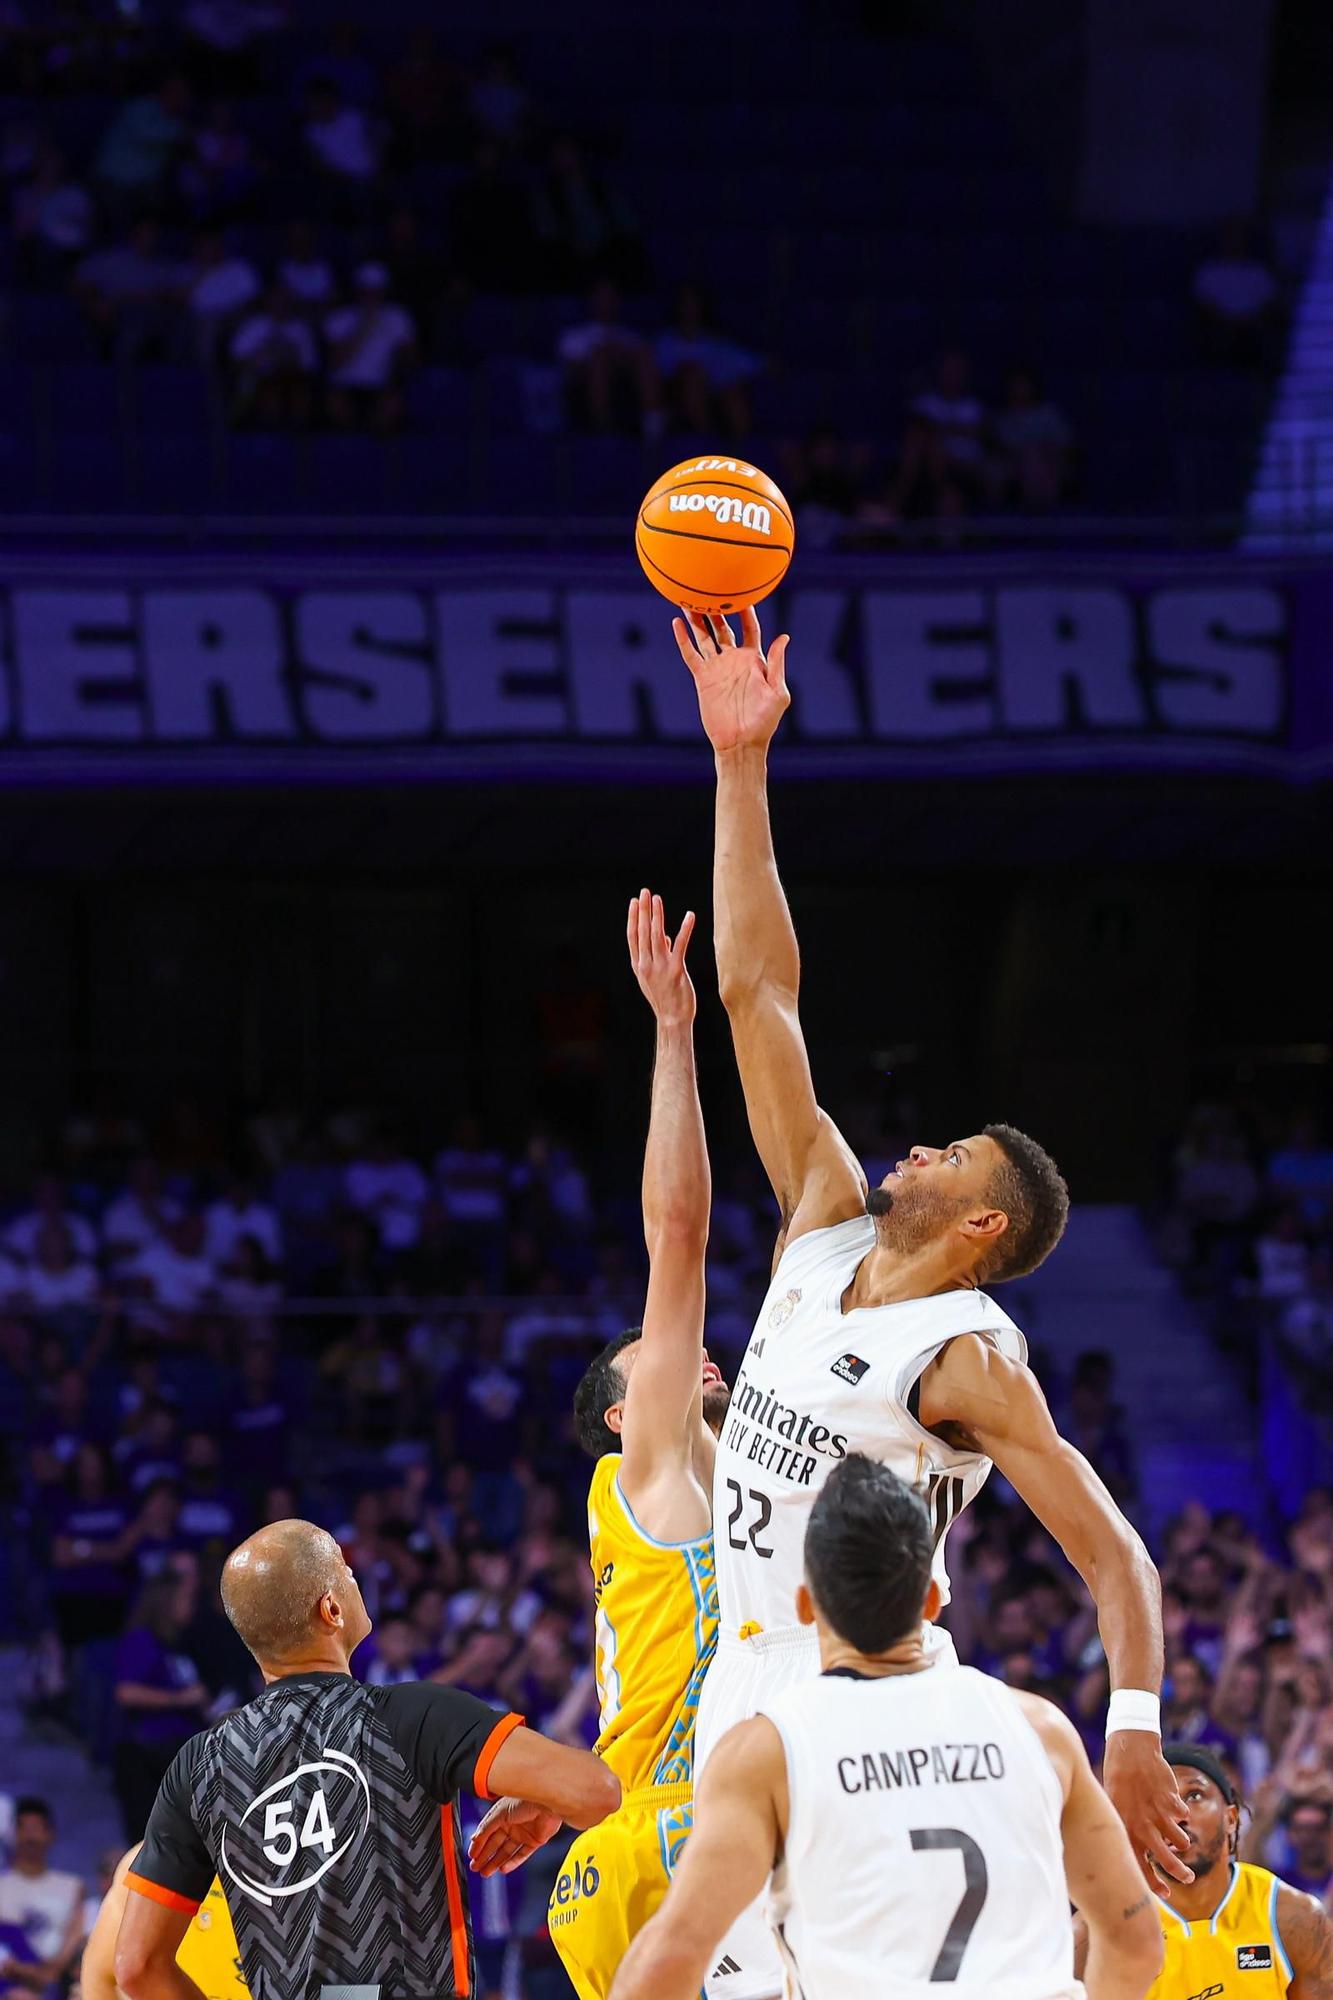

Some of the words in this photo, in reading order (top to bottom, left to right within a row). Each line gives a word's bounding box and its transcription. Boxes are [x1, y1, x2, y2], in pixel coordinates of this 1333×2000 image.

[669, 494, 772, 535] Wilson
[0, 587, 1286, 739] ERSERKERS
[726, 1418, 749, 1453] FLY
[747, 1432, 818, 1485] BETTER
[726, 1478, 774, 1559] 22
[837, 1743, 1005, 1794] CAMPAZZO
[262, 1789, 337, 1866] 54
[909, 1828, 988, 1982] 7
